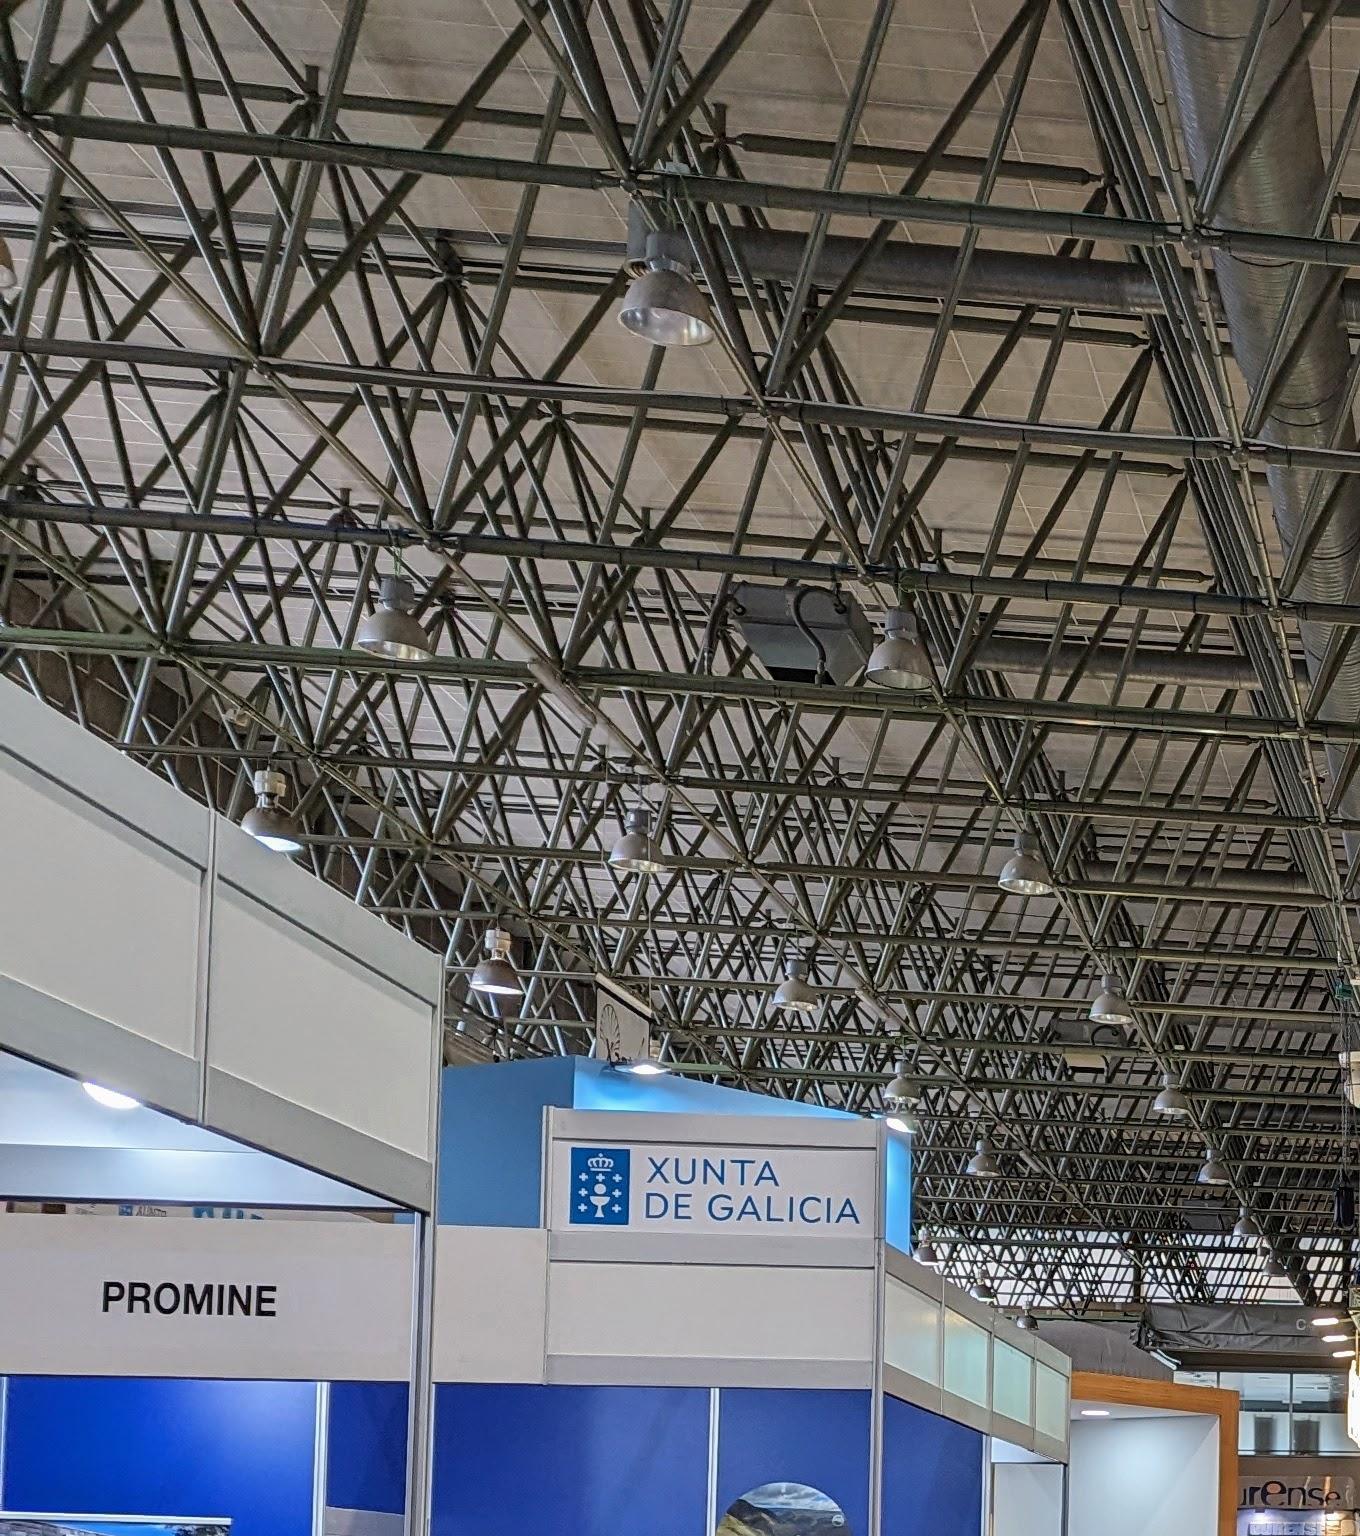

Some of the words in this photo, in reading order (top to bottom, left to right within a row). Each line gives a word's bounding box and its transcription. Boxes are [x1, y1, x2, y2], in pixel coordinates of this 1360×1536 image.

[646, 1156, 780, 1187] XUNTA
[644, 1192, 693, 1220] DE
[707, 1194, 860, 1225] GALICIA
[102, 1281, 277, 1317] PROMINE
